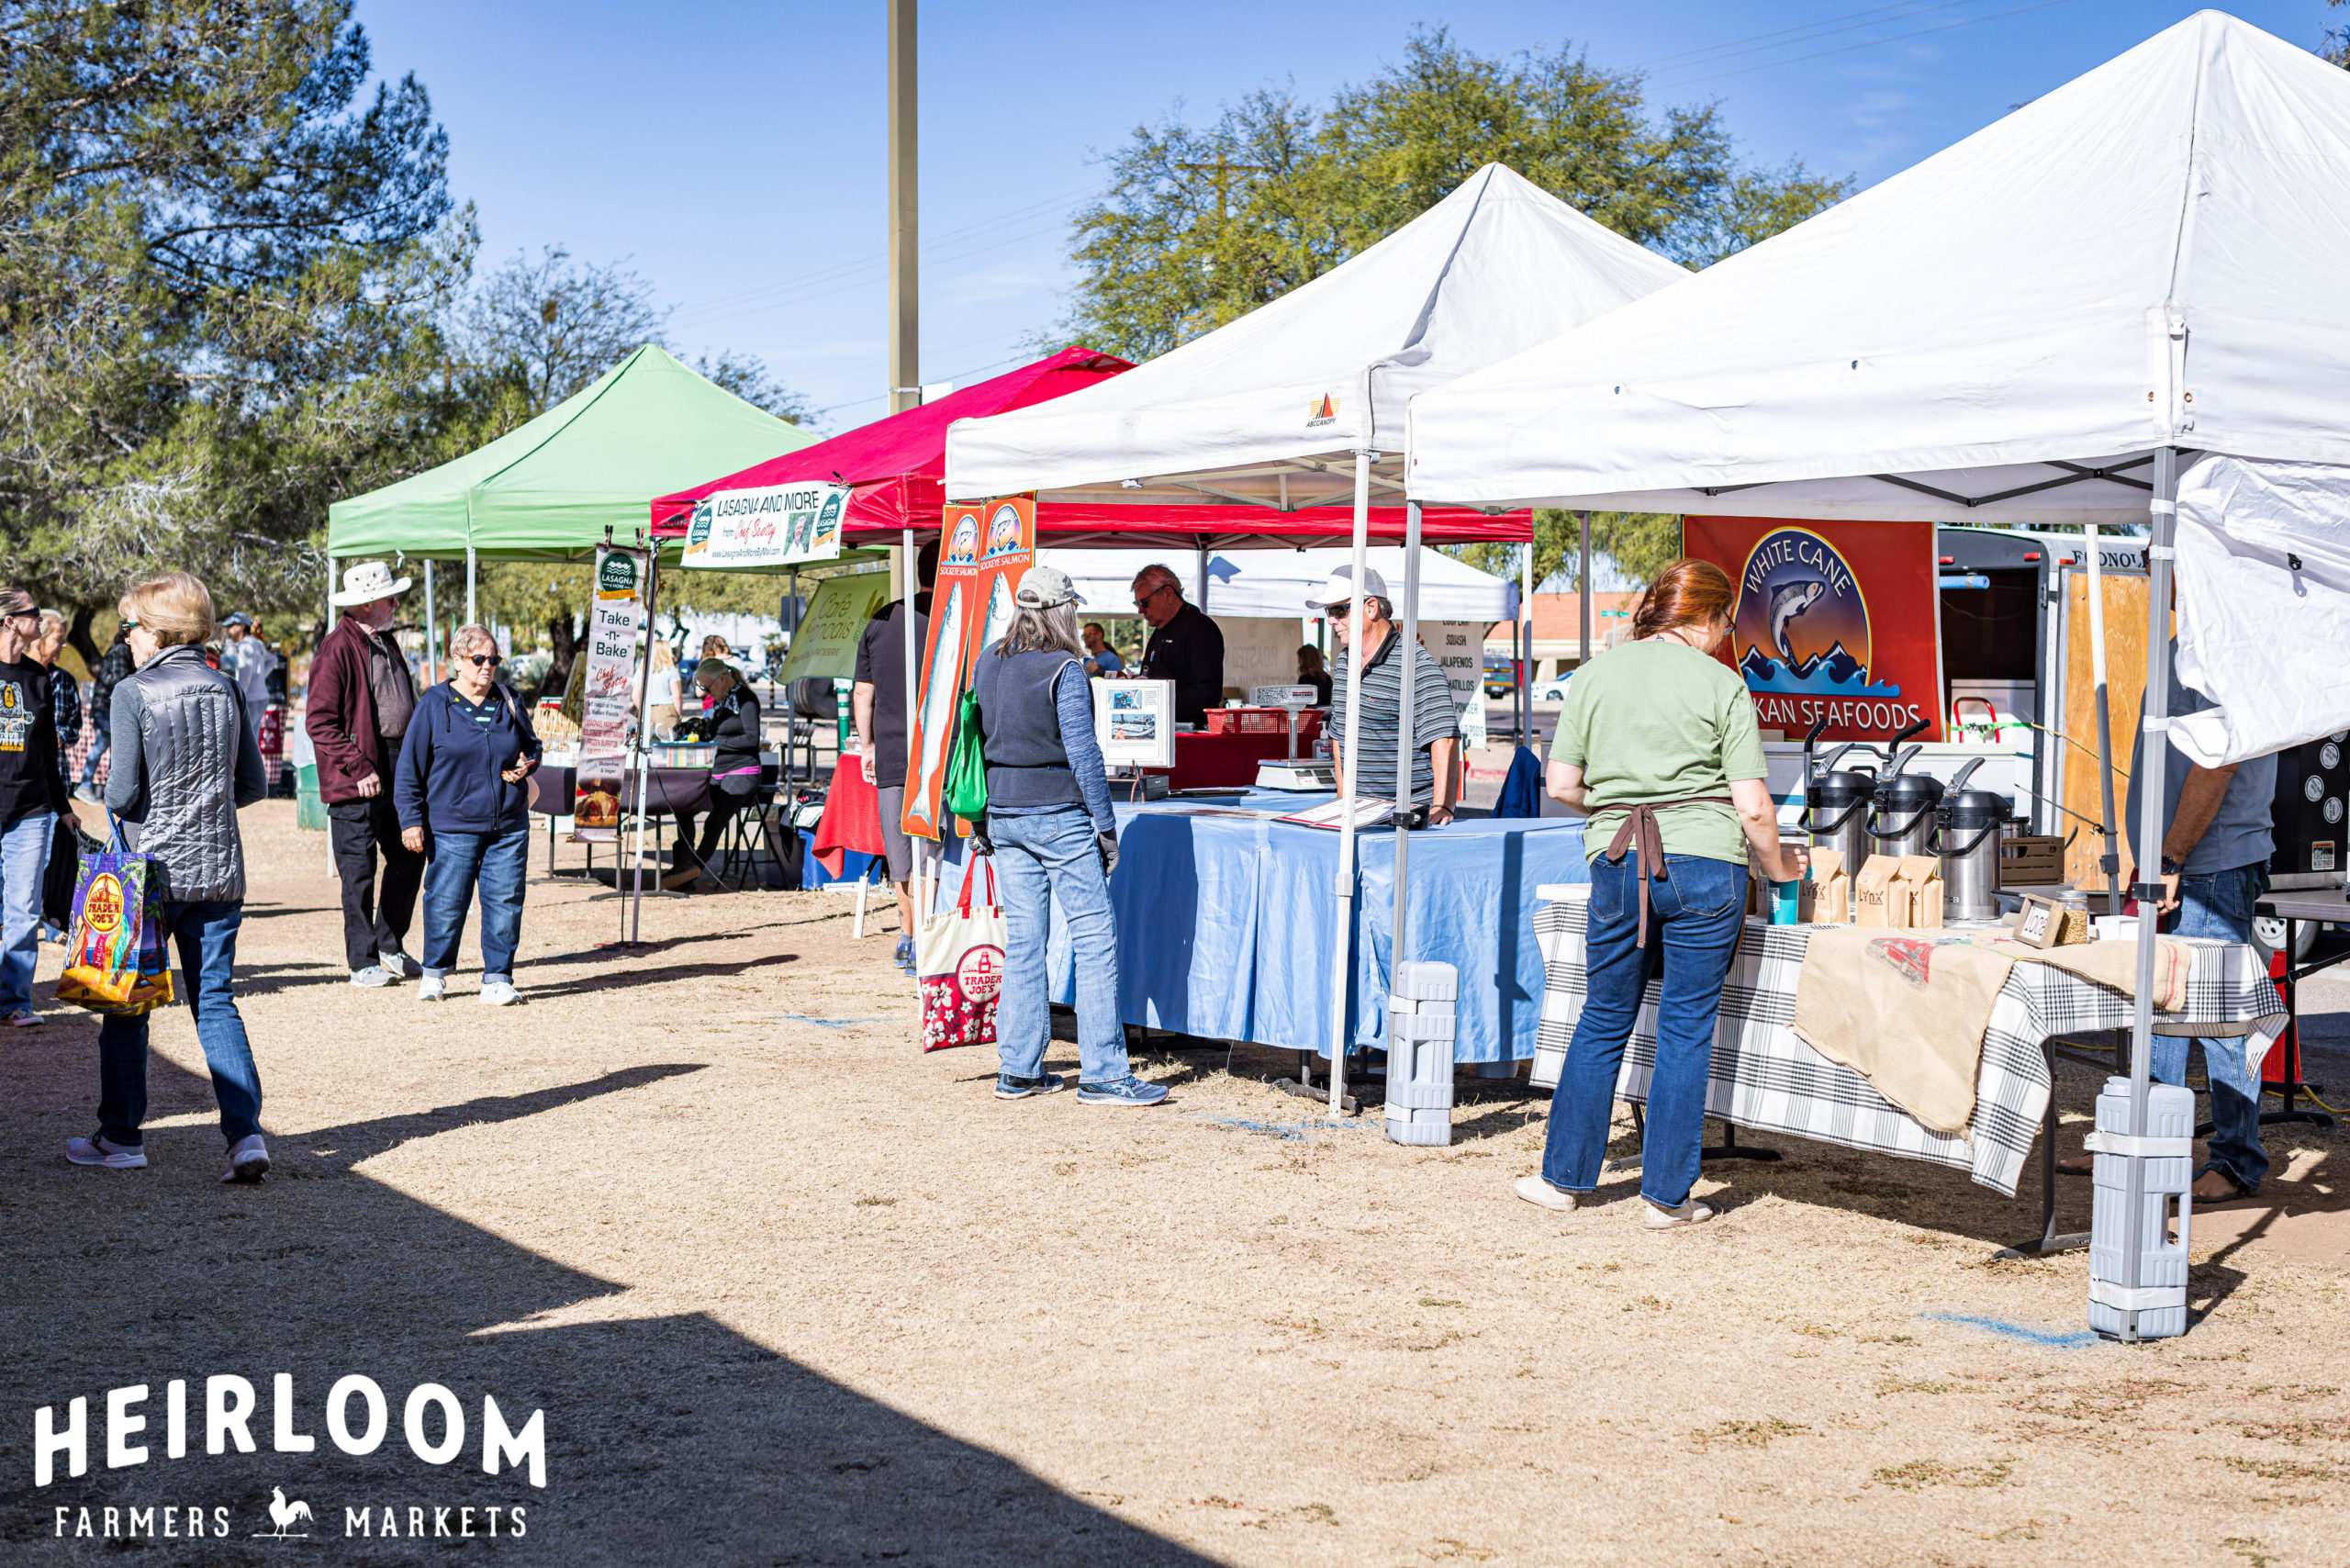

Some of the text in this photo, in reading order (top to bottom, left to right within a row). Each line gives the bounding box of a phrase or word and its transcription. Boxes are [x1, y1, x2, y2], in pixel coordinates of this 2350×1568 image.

[717, 490, 820, 517] LASAGNA AND MORE
[979, 554, 1030, 571] SOCKEYE SALMON
[1746, 539, 1852, 598] WHITE CANE
[939, 566, 978, 577] SOCKEYE SALMON
[601, 574, 633, 586] LASAGNA
[1445, 633, 1468, 646] SQUASH
[596, 664, 615, 681] Chef
[601, 676, 628, 691] Scotty
[1448, 680, 1475, 692] MATILLOS
[1754, 697, 1921, 730] KAN SEAFOODS
[88, 903, 119, 913] TRADER
[965, 975, 1002, 985] TRADER
[968, 985, 995, 994] JOE'S
